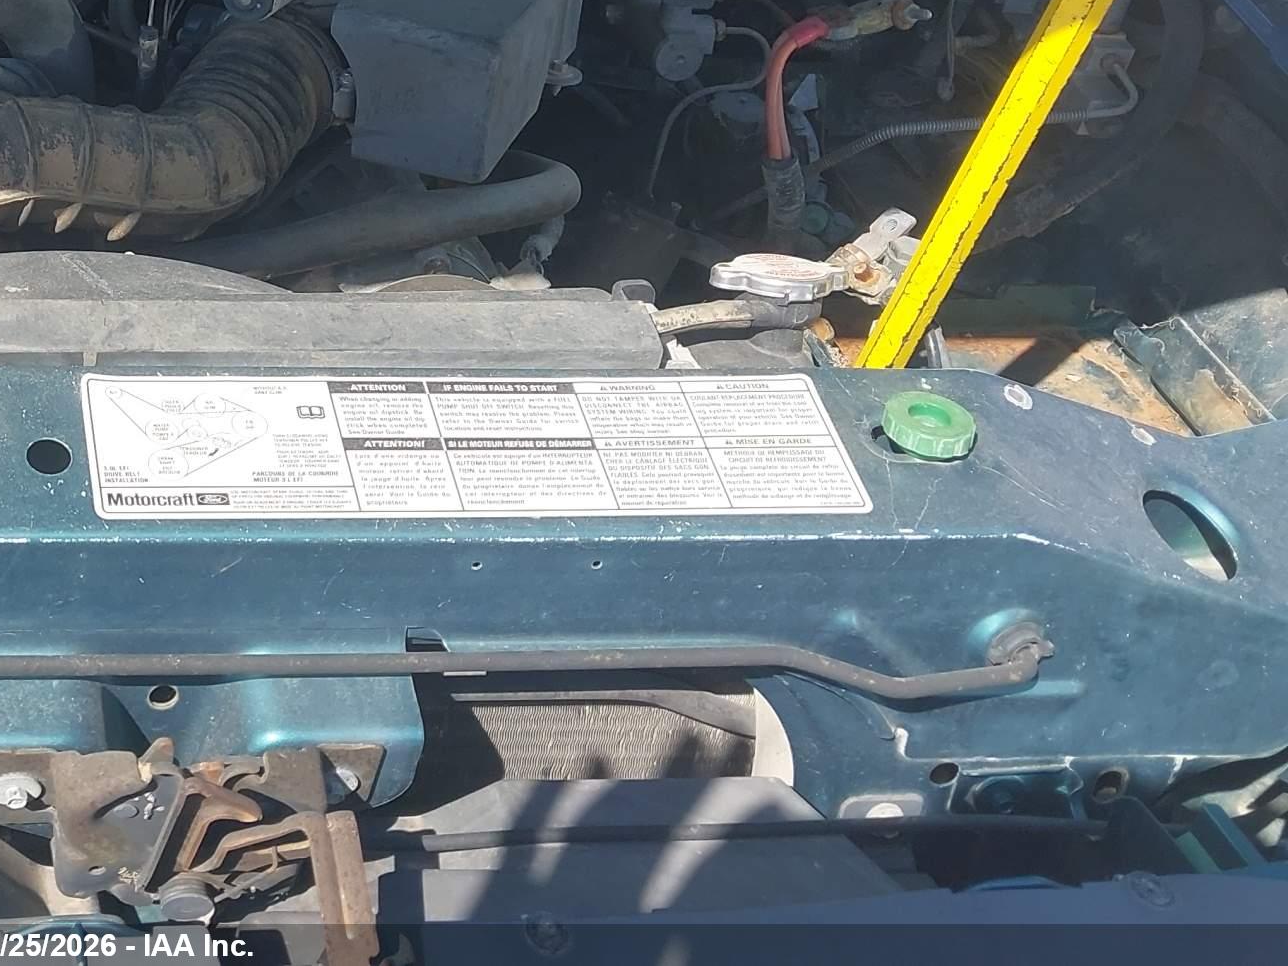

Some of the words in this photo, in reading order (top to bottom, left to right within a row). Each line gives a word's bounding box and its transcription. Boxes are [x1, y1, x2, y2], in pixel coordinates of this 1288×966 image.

[350, 384, 406, 392] ATTENTION
[443, 384, 451, 392] IF
[454, 384, 488, 392] ENGINE
[489, 384, 514, 392] FAILS
[516, 384, 529, 392] TO
[530, 384, 558, 392] START
[364, 440, 425, 448] ATTENTION!
[448, 440, 456, 448] SI
[458, 440, 468, 448] LE
[470, 440, 503, 448] MOTEUR
[504, 440, 534, 448] REFUSE
[536, 439, 547, 448] DE
[107, 493, 195, 506] Motorcraft
